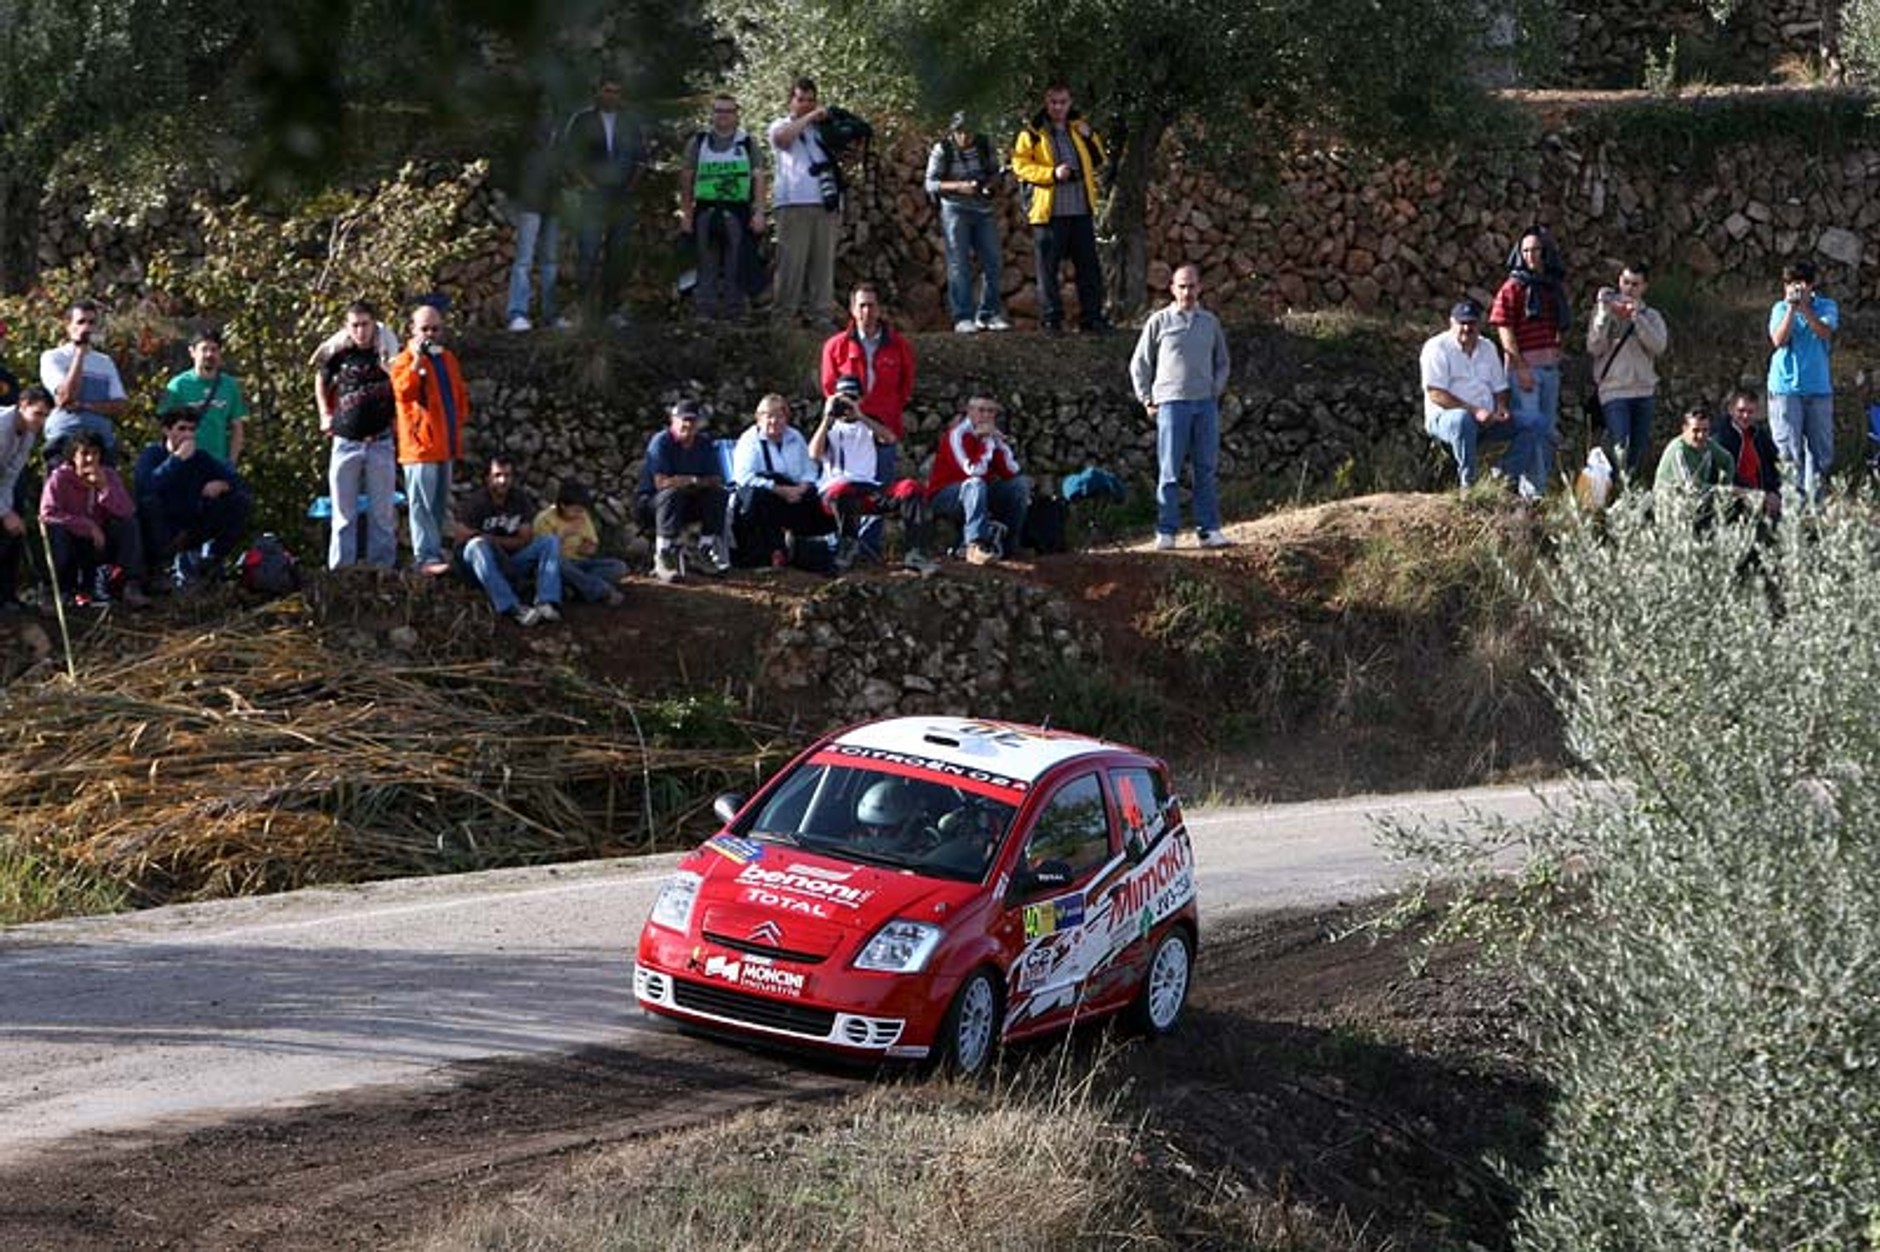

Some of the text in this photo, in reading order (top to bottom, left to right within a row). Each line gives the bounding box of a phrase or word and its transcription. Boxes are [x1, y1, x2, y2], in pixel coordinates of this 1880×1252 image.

[740, 863, 866, 901] benoni
[749, 889, 828, 918] TOTAL
[1026, 949, 1051, 968] C2
